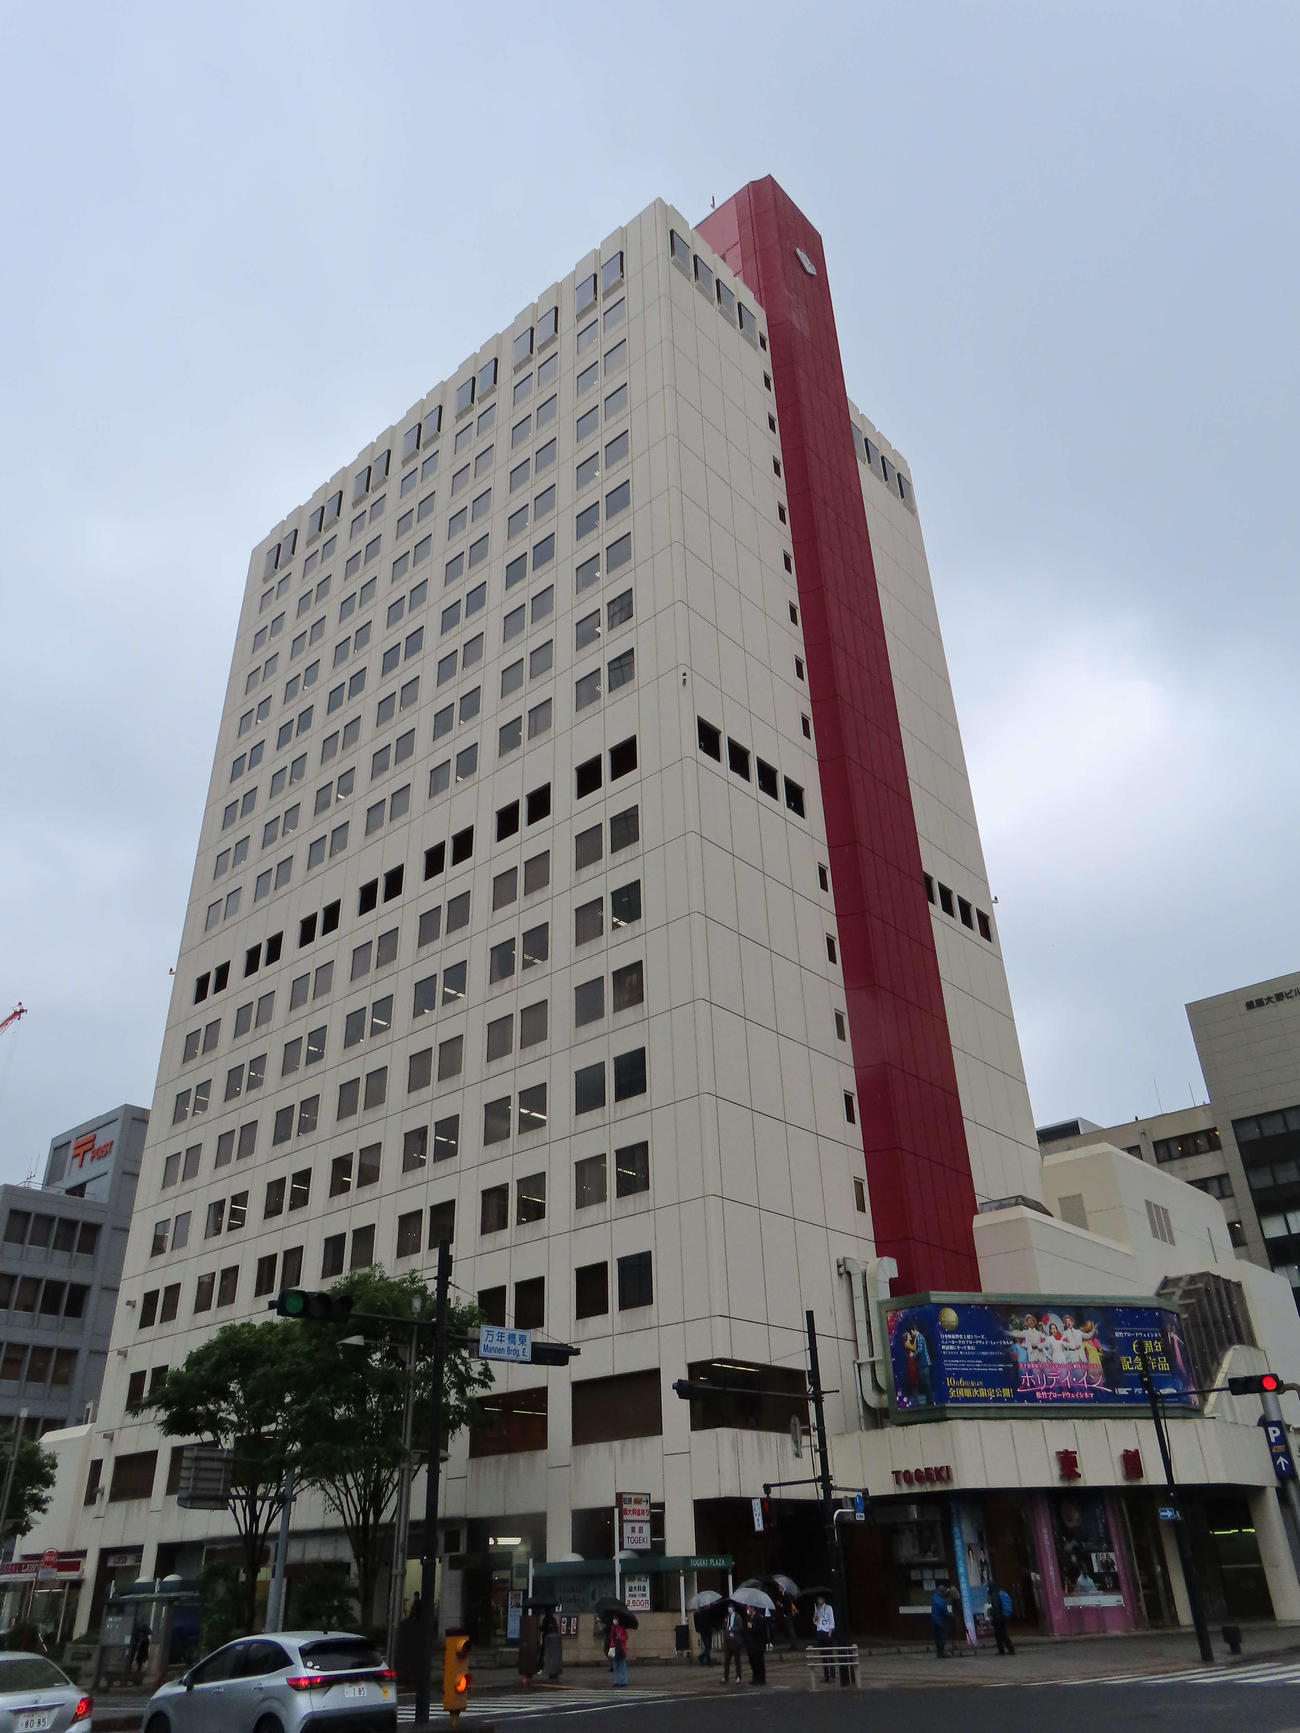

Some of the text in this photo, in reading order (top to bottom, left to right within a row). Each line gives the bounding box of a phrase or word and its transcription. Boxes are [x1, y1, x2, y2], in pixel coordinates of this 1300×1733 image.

[485, 1331, 527, 1346] 万年橋東
[1020, 1369, 1103, 1390] ホリデイ・イン
[1268, 1427, 1280, 1443] P
[892, 1465, 952, 1485] TOGEKI
[710, 1558, 726, 1567] PLAZA
